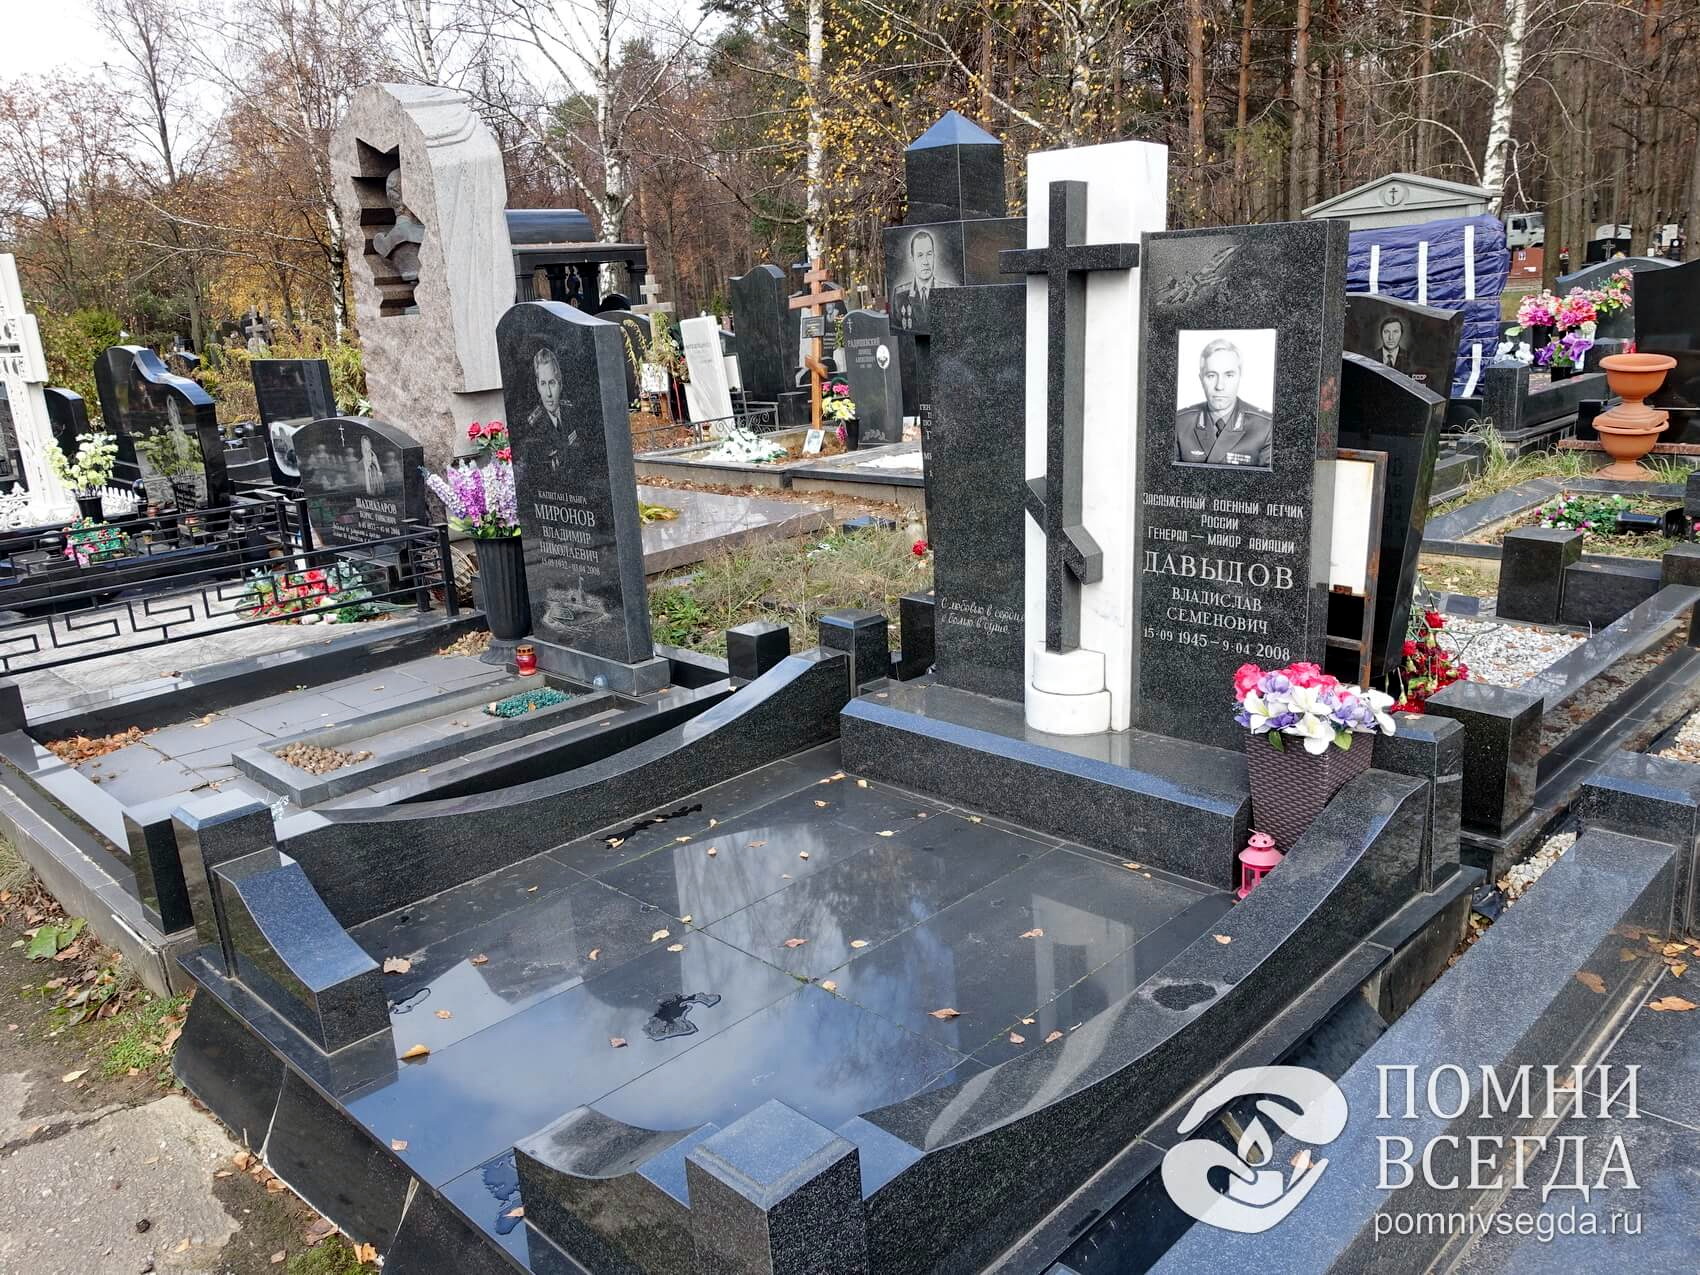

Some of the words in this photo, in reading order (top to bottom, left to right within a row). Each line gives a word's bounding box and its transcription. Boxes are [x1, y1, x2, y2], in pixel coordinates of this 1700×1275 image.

[534, 503, 595, 527] МИРОНОВ
[1143, 492, 1206, 510] ЗАСЛУЖЕННЫЙ
[1213, 499, 1259, 515] ВОЕННЫЙ
[1266, 503, 1304, 519] ЛЕТЧИК
[542, 526, 591, 544] ВЛАДИМИР
[1201, 514, 1239, 531] РОССИИ
[540, 541, 598, 563] НИКОЛАЕВИЧ
[1148, 526, 1188, 543] ГЕНЕРАЛ
[1207, 533, 1242, 549] МАЙОР
[1249, 537, 1295, 555] АВИАЦИИ
[1143, 550, 1294, 590] ДАВЫДОВ
[948, 599, 985, 615] любовью
[1172, 586, 1263, 613] ВЛАДИСЛАВ
[1166, 607, 1268, 634] СЕМЕНОВИЧ
[1178, 631, 1208, 648] 1945
[1256, 643, 1291, 662] 2008
